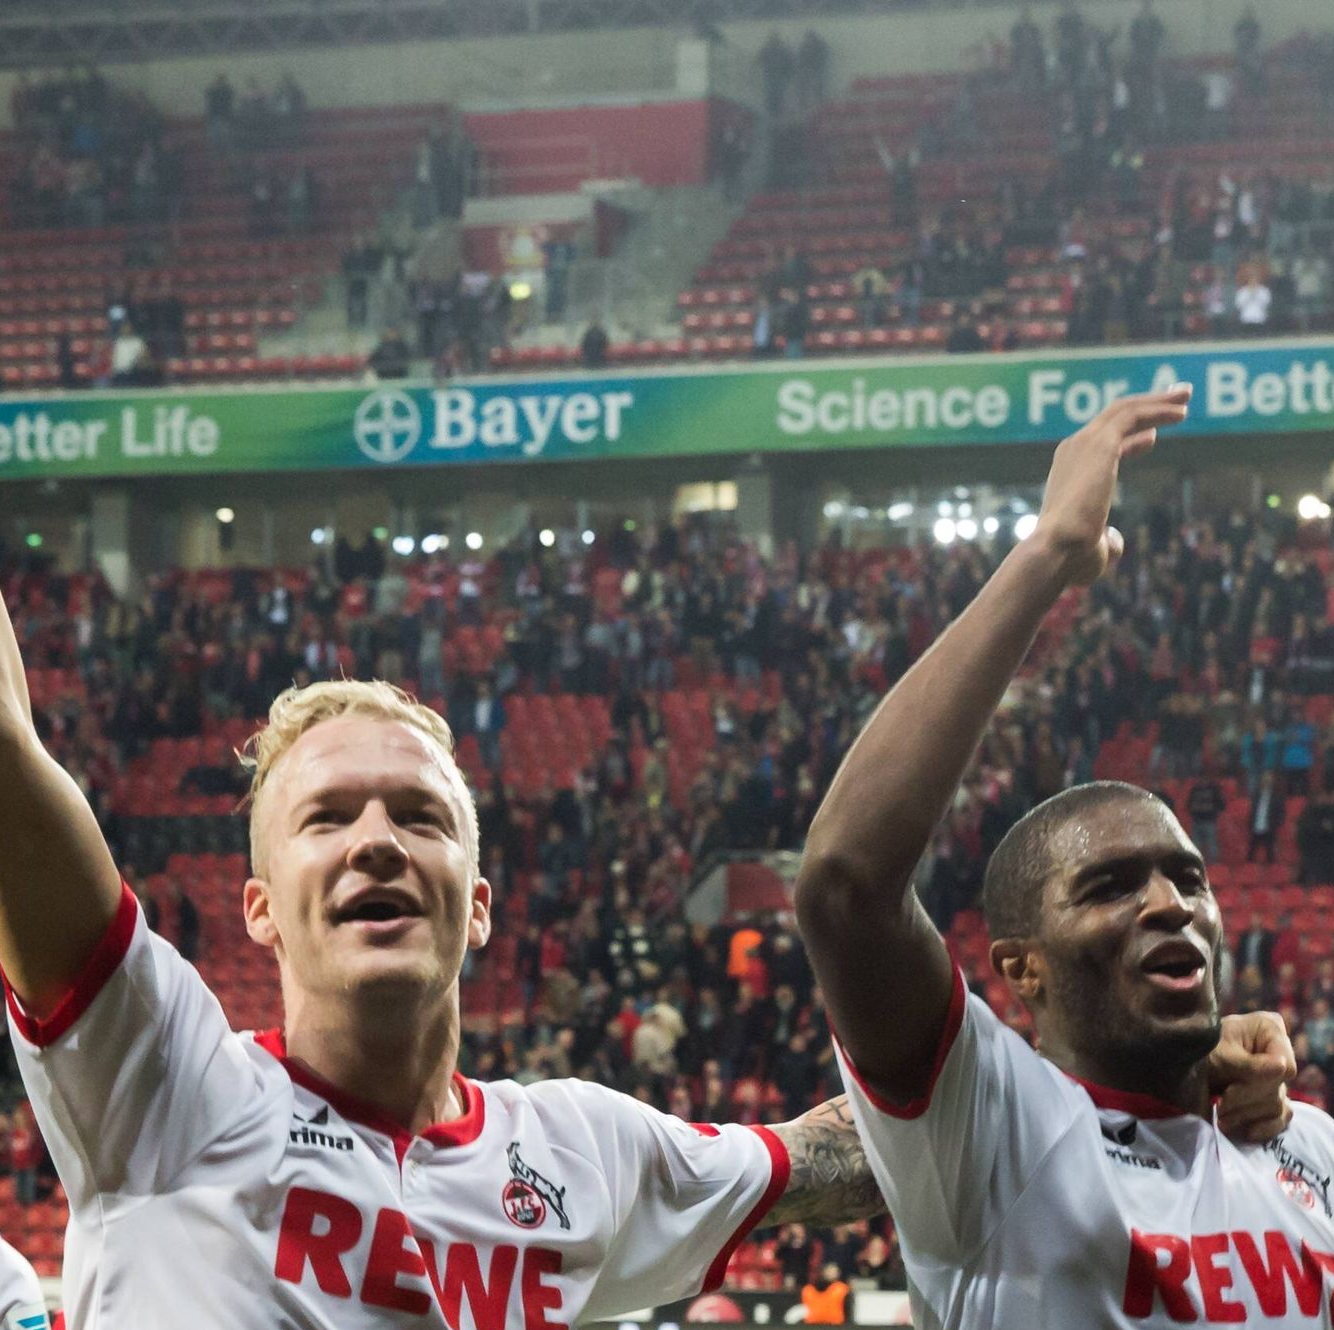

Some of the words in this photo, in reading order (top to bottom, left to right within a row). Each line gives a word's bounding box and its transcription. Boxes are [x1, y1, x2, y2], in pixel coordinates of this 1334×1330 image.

[122, 405, 219, 457] Life
[428, 389, 632, 455] Bayer
[777, 378, 1009, 434] Science
[290, 1126, 354, 1151] rima
